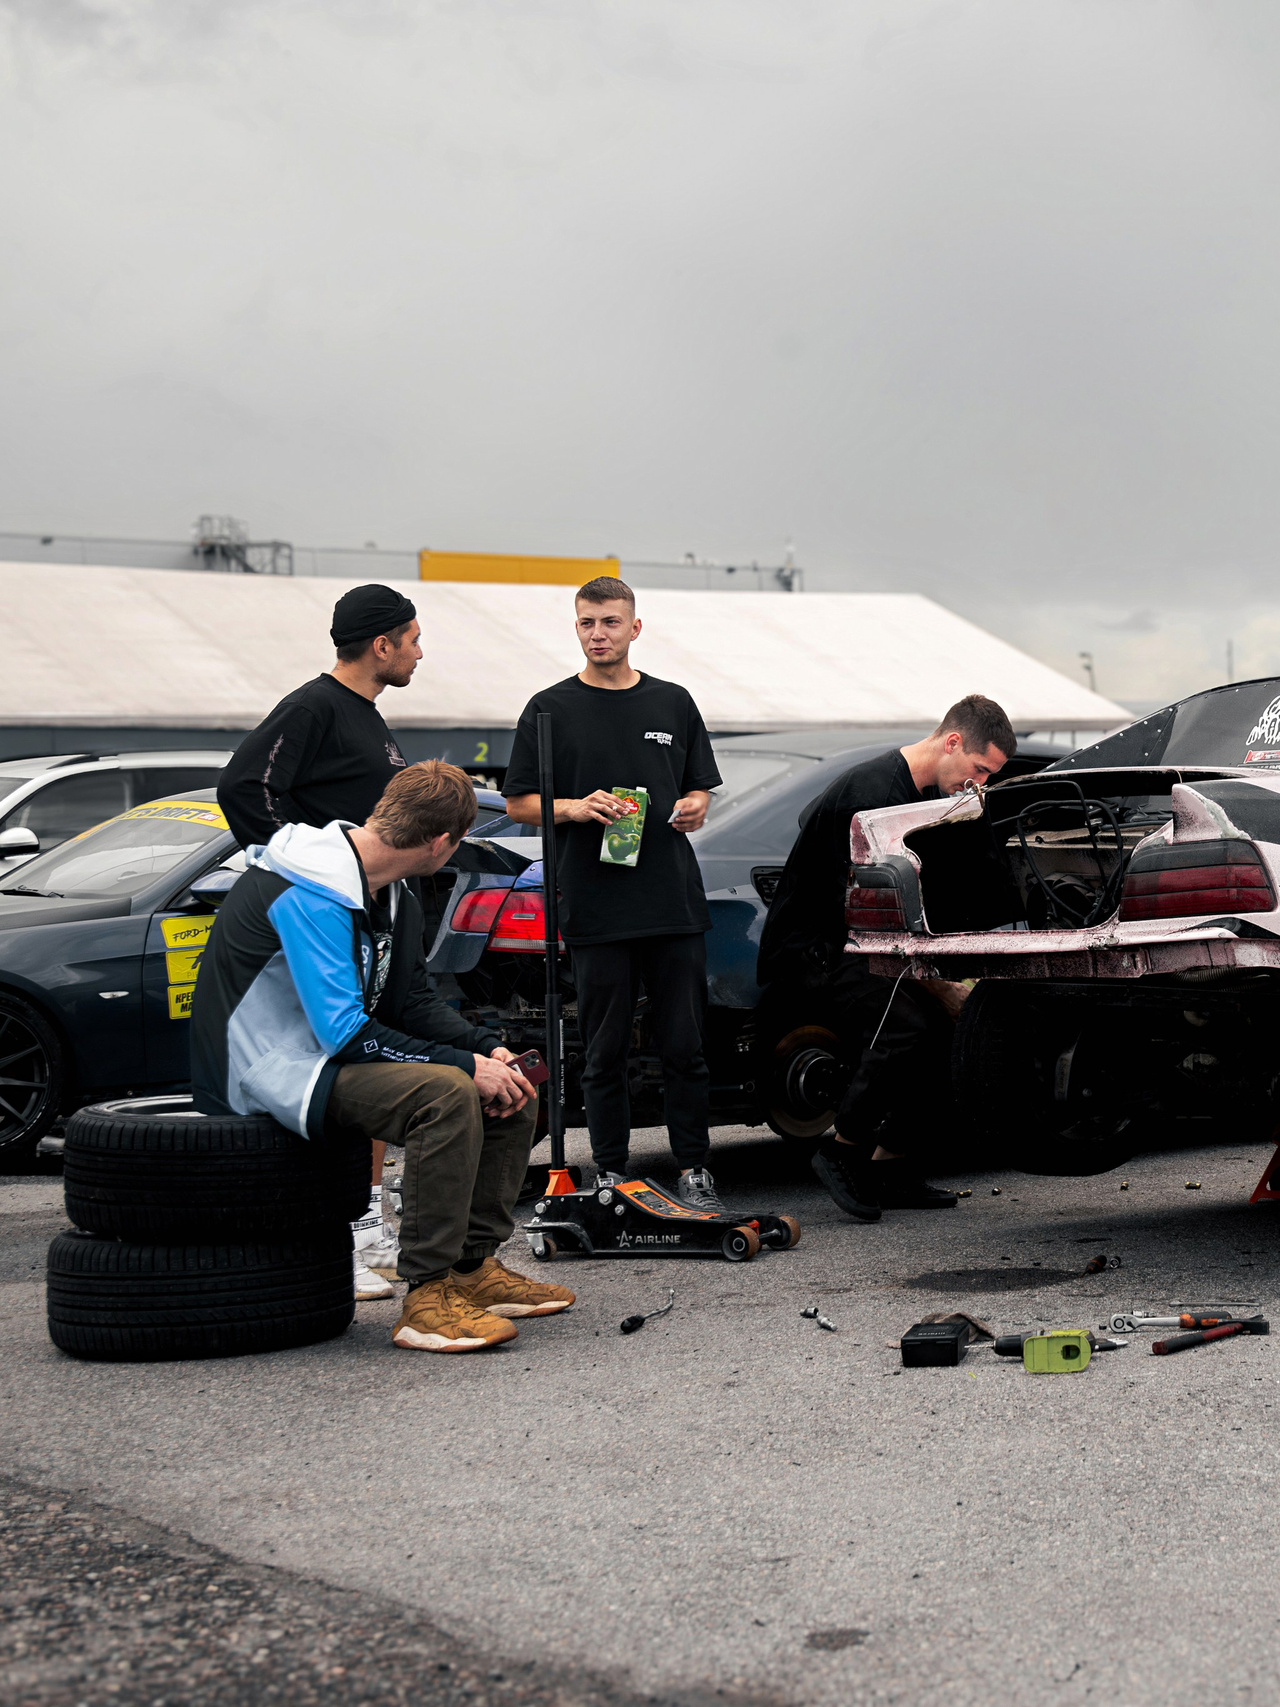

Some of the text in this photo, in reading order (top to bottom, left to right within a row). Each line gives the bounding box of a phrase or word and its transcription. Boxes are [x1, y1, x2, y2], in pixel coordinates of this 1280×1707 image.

[644, 731, 673, 741] OCEAN
[474, 742, 488, 761] 2
[173, 925, 213, 942] FORD-M
[634, 1234, 681, 1244] AIRLINE
